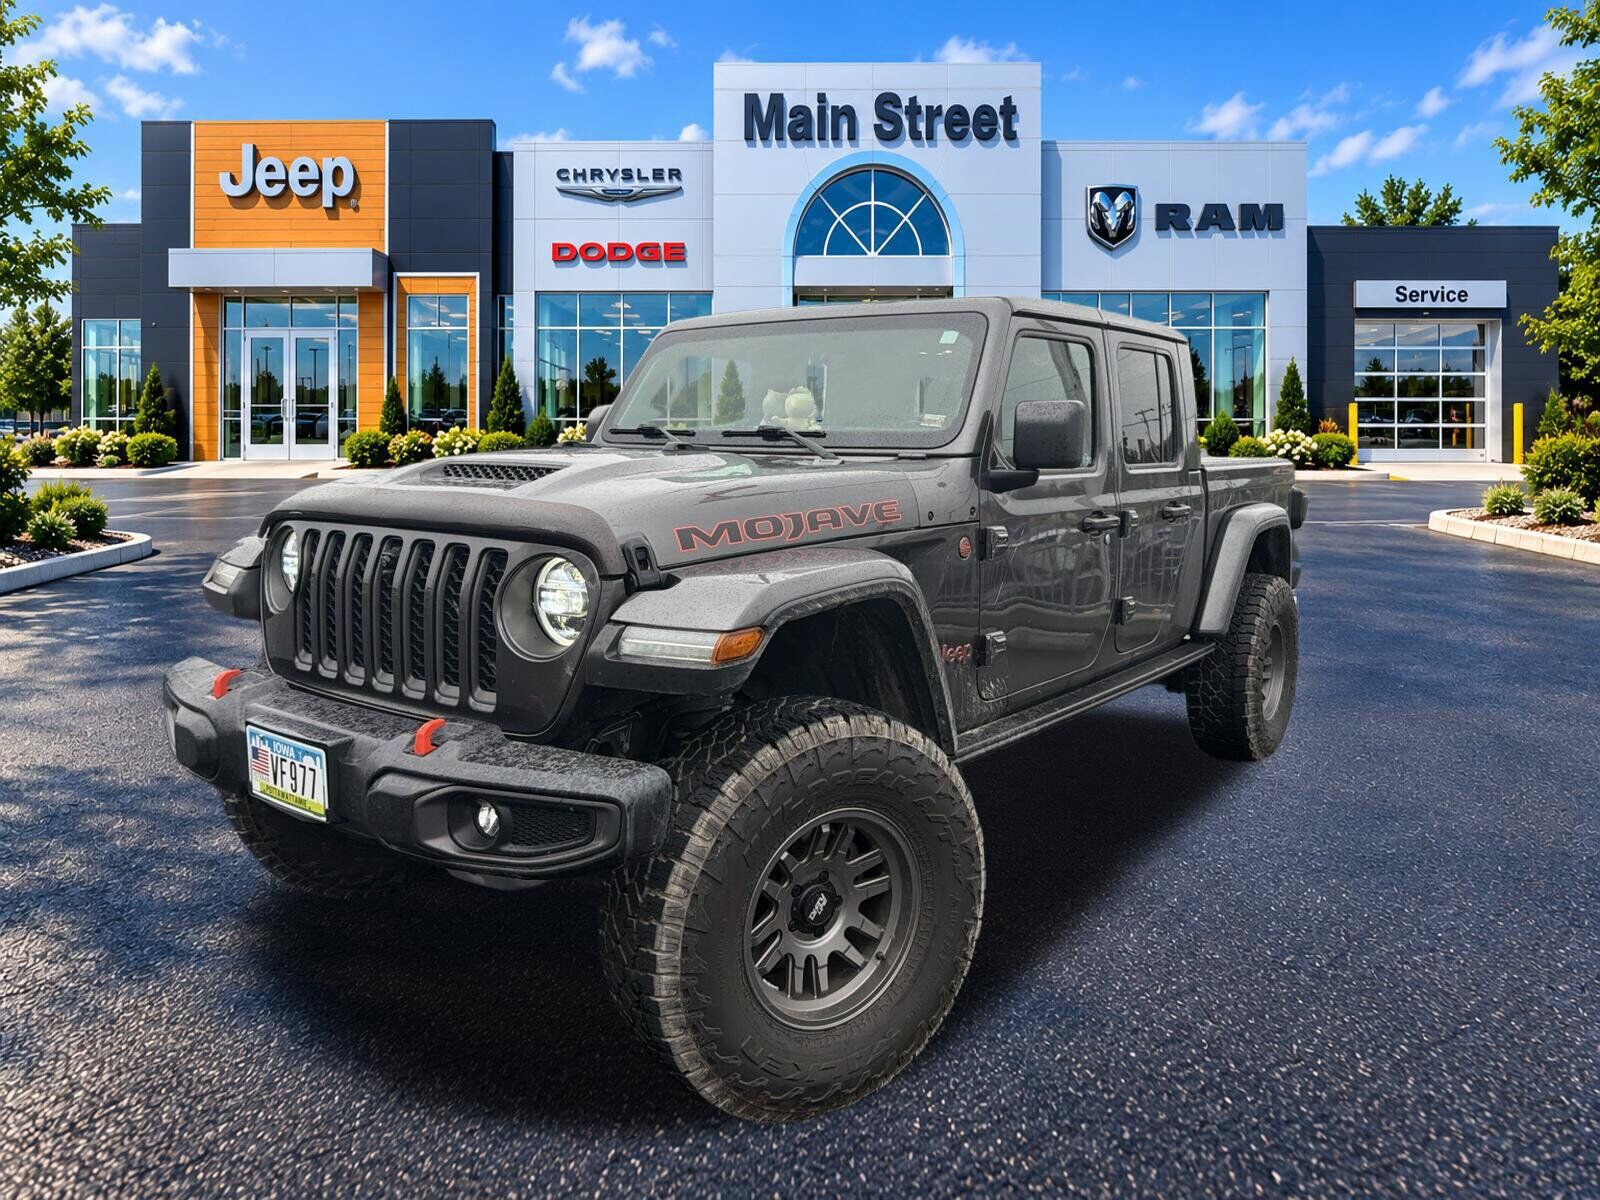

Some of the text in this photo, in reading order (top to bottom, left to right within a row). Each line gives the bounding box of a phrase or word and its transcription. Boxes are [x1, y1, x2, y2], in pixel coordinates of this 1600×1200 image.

[743, 91, 1017, 141] Main Street
[218, 143, 355, 208] Jeep
[555, 167, 683, 182] CHRYSLER
[1154, 203, 1285, 232] RAM
[551, 242, 687, 262] DODGE
[1395, 285, 1469, 303] Service
[673, 499, 903, 552] MOJAVE
[273, 741, 296, 758] IOWA
[270, 753, 316, 800] VF977
